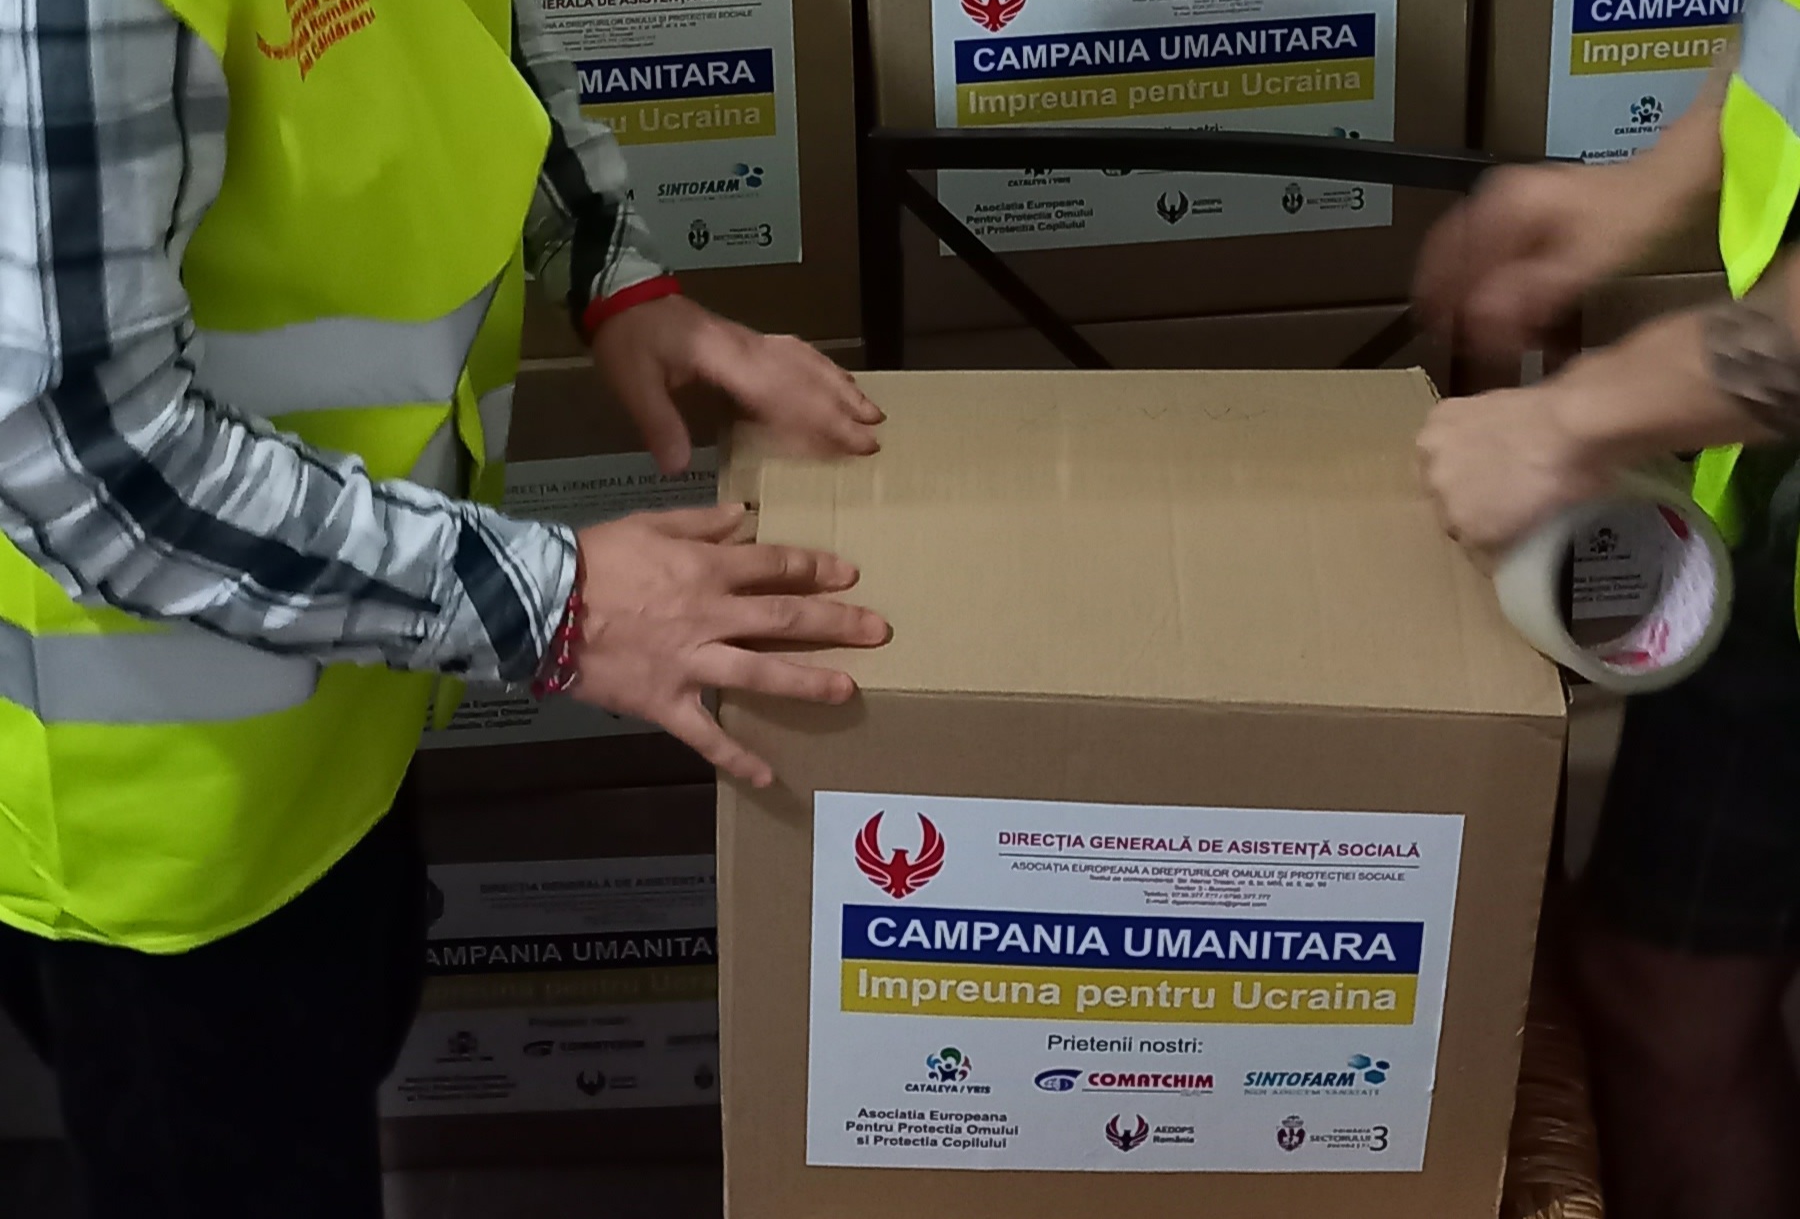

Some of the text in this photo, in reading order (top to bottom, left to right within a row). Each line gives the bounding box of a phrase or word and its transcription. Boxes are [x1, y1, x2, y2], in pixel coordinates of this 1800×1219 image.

[973, 24, 1358, 72] CAMPANIA UMANITARA
[1583, 37, 1727, 66] Impreuna
[577, 60, 755, 94] MANITARA
[969, 67, 1361, 117] Impreuna pentru Ucraina
[637, 103, 762, 132] Ucraina
[1198, 840, 1224, 853] DE
[426, 935, 714, 966] AMPANIA UMANITA
[866, 916, 1399, 962] CAMPANIA UMANITARA
[858, 968, 1398, 1013] Impreuna pentru Ucraina
[1047, 1035, 1203, 1053] Prietenii nostri:
[1087, 1073, 1214, 1088] COMATCHIM
[1243, 1072, 1355, 1087] SINTOFARM
[846, 1122, 1019, 1135] Pentru Protectia Omului
[857, 1108, 1007, 1123] Asociatia Europeana
[857, 1135, 1006, 1149] si Protectia Copilului
[1369, 1126, 1390, 1152] 3
